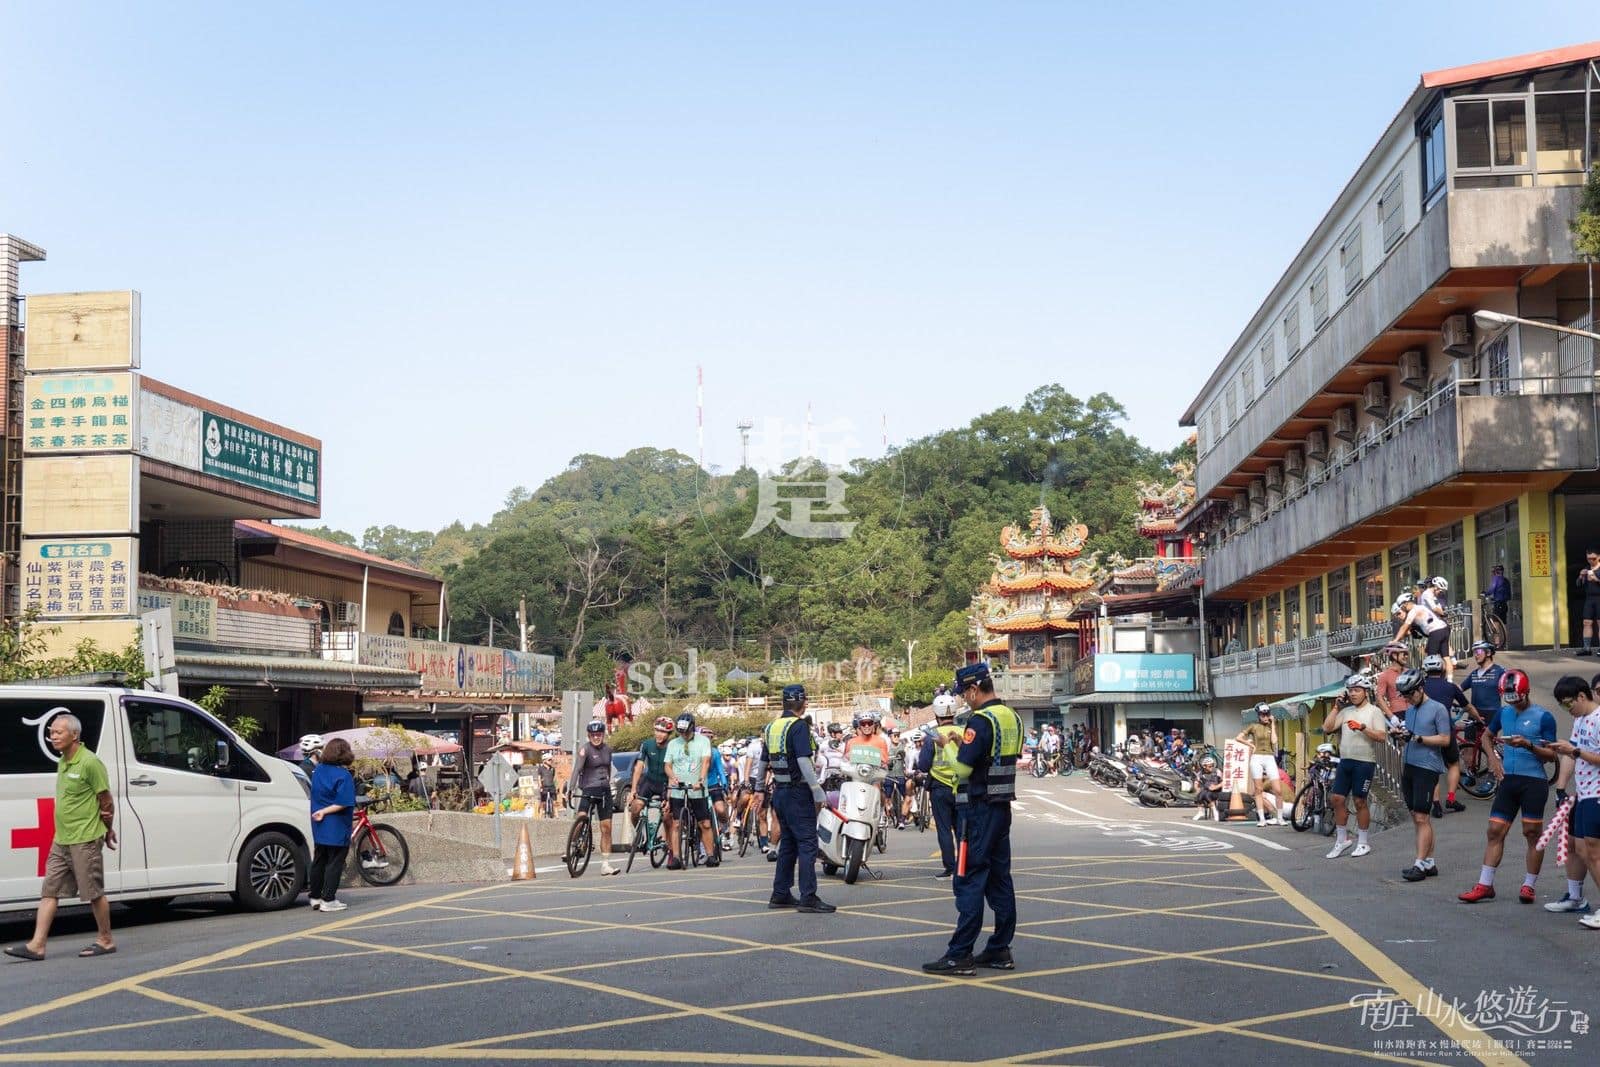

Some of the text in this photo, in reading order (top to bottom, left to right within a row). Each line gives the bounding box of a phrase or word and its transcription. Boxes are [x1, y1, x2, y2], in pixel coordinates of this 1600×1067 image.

[50, 397, 66, 447] 四季春
[71, 396, 88, 446] 佛手茶
[1232, 748, 1245, 779] 花生
